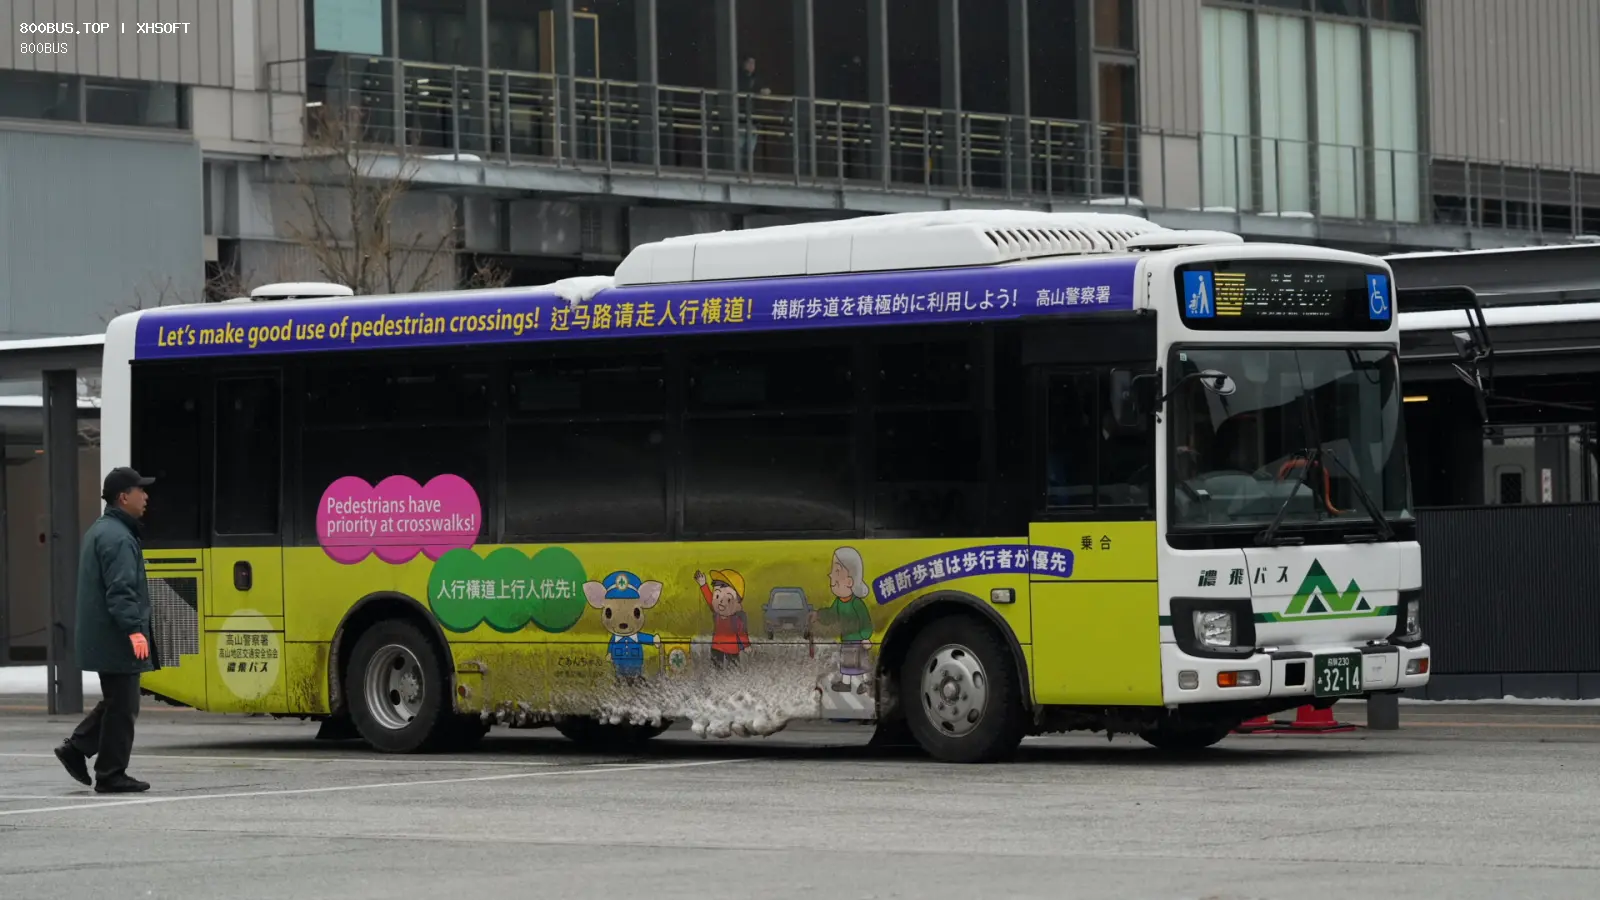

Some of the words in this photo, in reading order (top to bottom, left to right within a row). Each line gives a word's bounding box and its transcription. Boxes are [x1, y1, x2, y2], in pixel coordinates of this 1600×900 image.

[1035, 285, 1111, 308] 高山警察署
[157, 325, 195, 348] Let's
[199, 322, 244, 346] make
[247, 319, 293, 349] good
[295, 319, 327, 341] use
[329, 315, 350, 339] of
[350, 310, 447, 343] pedestrian
[449, 306, 541, 336] crossings!
[327, 496, 405, 515] Pedestrians
[408, 495, 441, 513] have
[327, 515, 377, 537] priority
[380, 516, 394, 532] at
[396, 513, 475, 532] crosswalks!
[879, 548, 1067, 599] 横断歩道は歩行者が優先
[226, 634, 269, 646] 高山警察署
